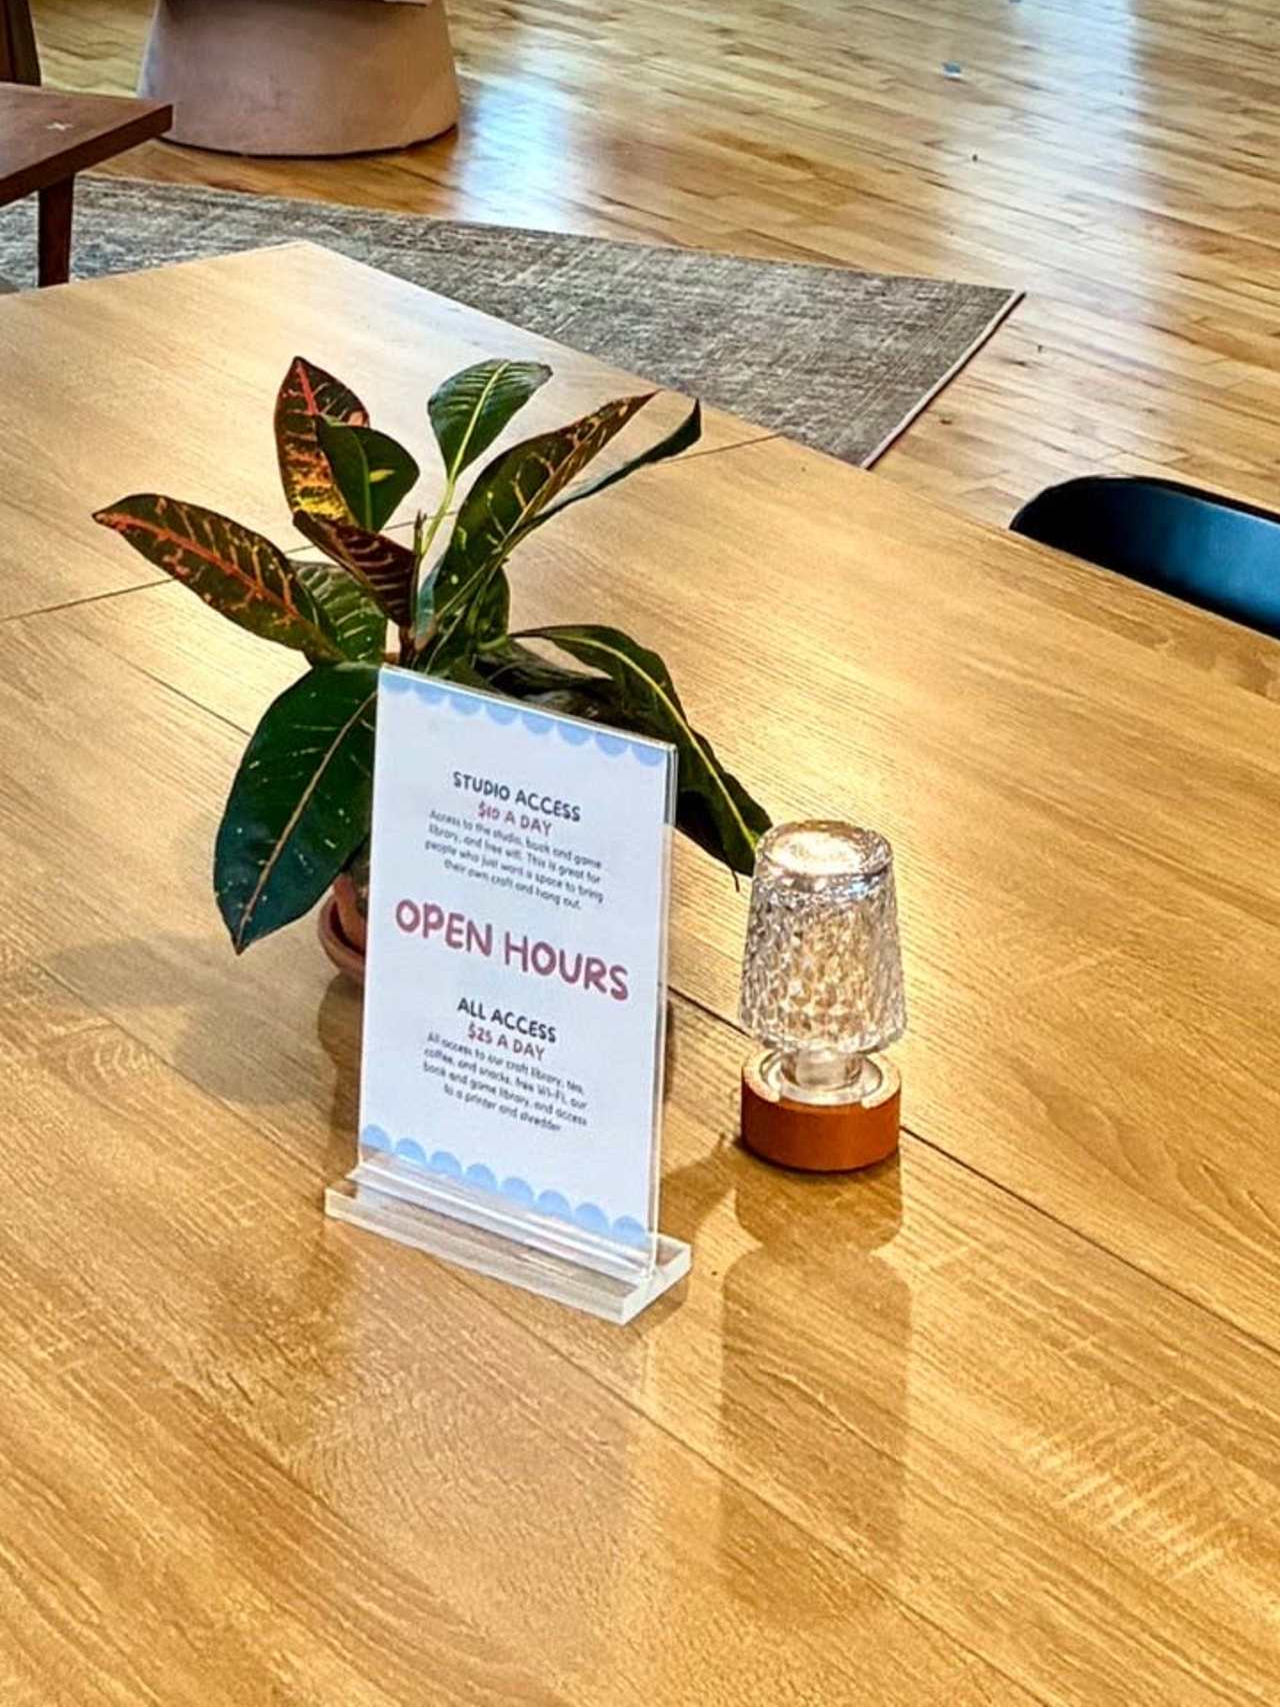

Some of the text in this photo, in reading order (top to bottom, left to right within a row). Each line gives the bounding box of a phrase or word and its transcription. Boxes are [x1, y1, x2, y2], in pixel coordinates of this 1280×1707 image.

[453, 771, 579, 821] STUDIO ACCESS
[396, 899, 627, 999] OPEN HOURS
[457, 997, 555, 1042] ALL ACCESS
[468, 1022, 544, 1060] $25 A DAY
